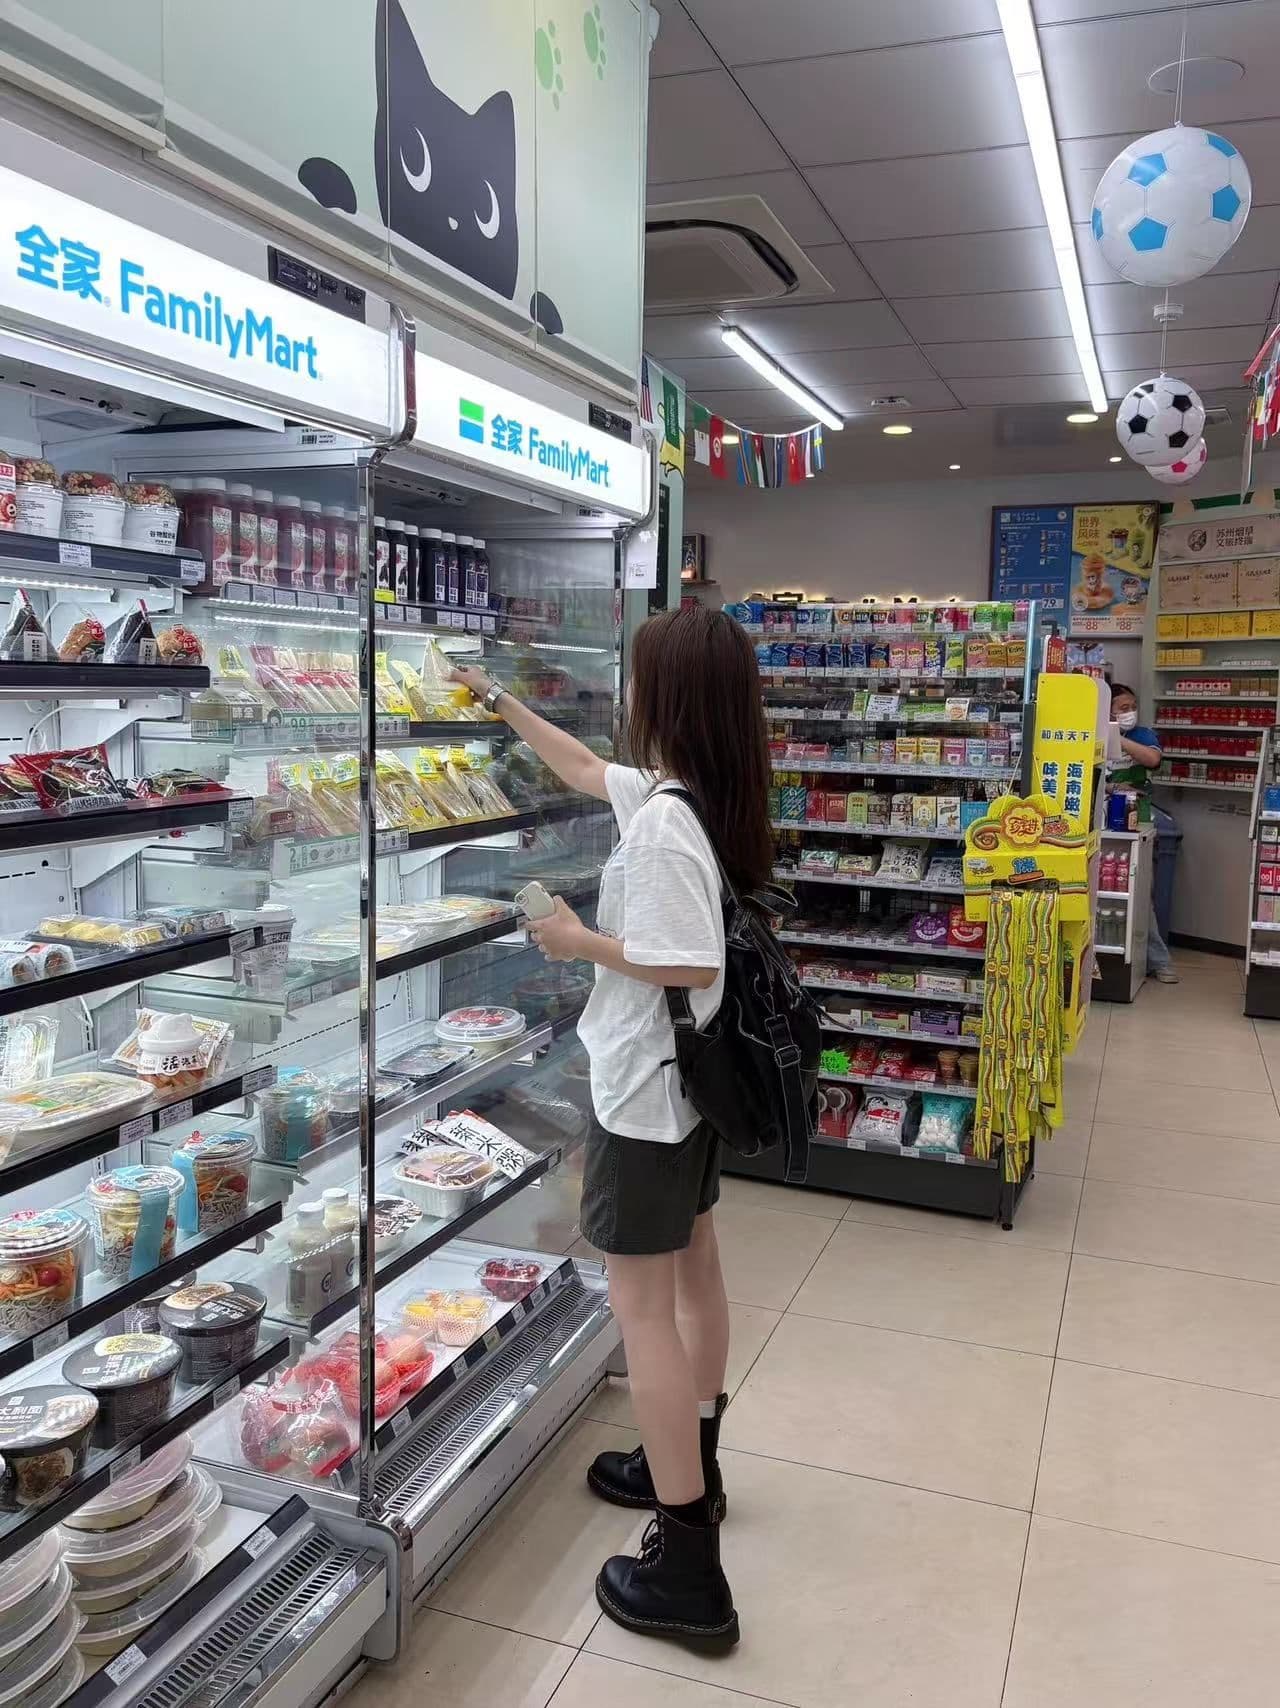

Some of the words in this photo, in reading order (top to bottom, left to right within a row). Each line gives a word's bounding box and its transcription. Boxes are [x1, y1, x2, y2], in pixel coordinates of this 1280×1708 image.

[15, 224, 103, 303] 全家
[120, 258, 318, 379] FamilyMart
[491, 415, 523, 454] 全家
[528, 427, 610, 487] FamilyMart
[1077, 528, 1100, 539] 风味
[1079, 516, 1100, 528] 世界
[1041, 729, 1091, 741] 和成天下
[1042, 761, 1059, 800] 味美
[1066, 762, 1084, 818] 海南嫩
[1008, 815, 1040, 837] 珍宝珠
[449, 1122, 526, 1173] 新米粥
